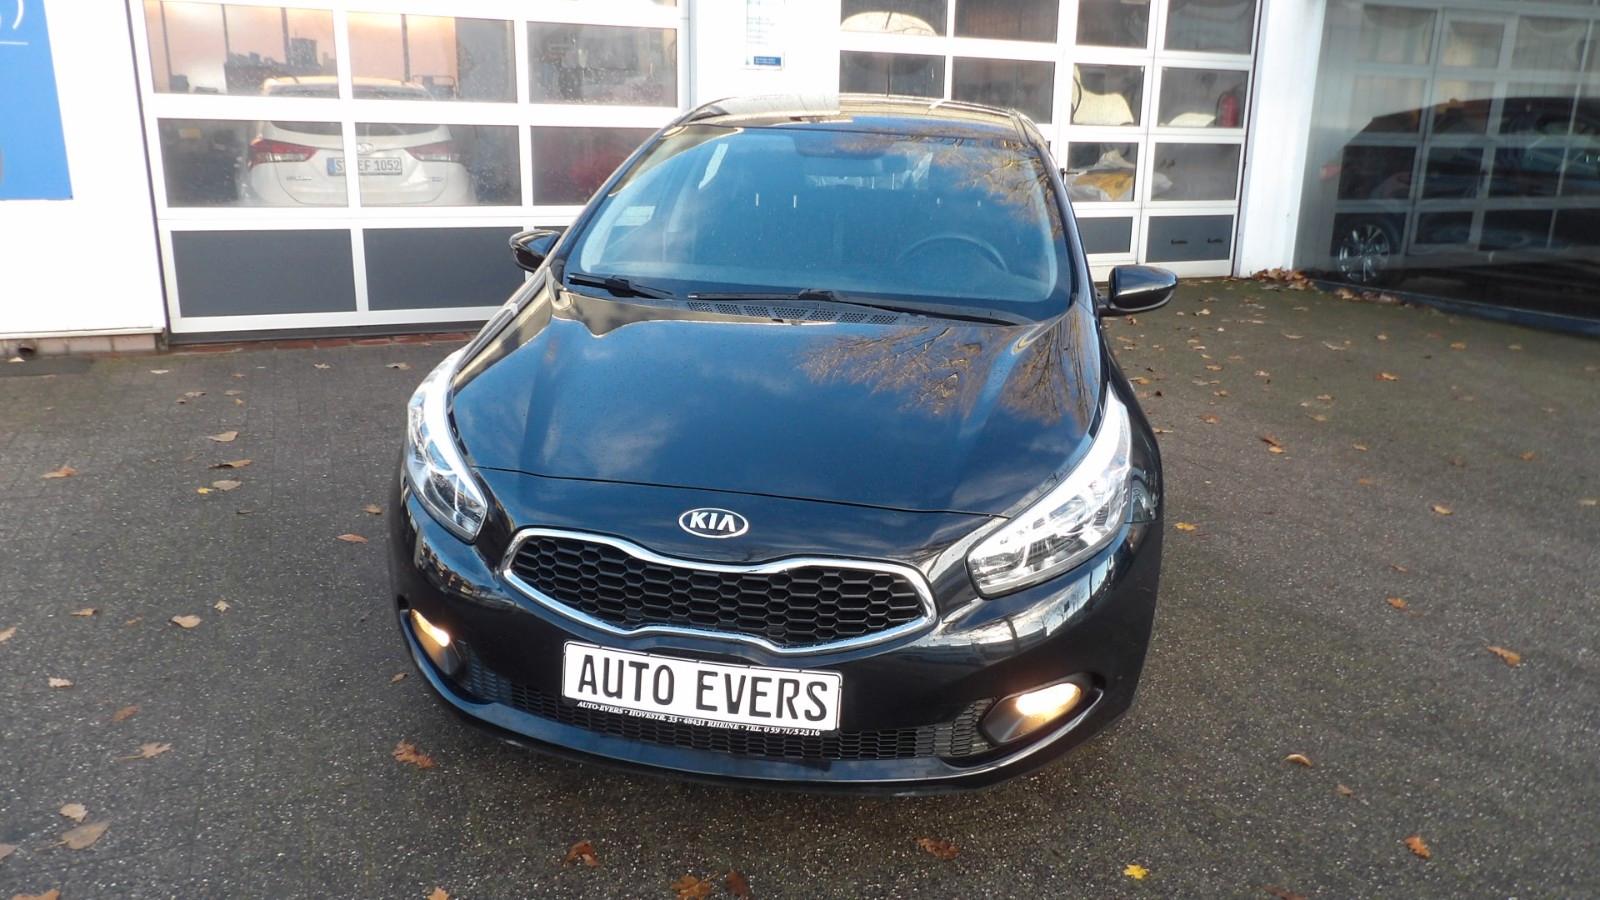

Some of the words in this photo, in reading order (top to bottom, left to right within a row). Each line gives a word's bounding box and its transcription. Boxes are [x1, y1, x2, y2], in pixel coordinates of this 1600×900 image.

[374, 159, 400, 171] 1052
[690, 511, 736, 532] KIA
[577, 654, 675, 706] AUTO
[695, 670, 829, 722] EVERS
[577, 701, 623, 714] AUTO-EVERS
[706, 719, 739, 730] RHEINE
